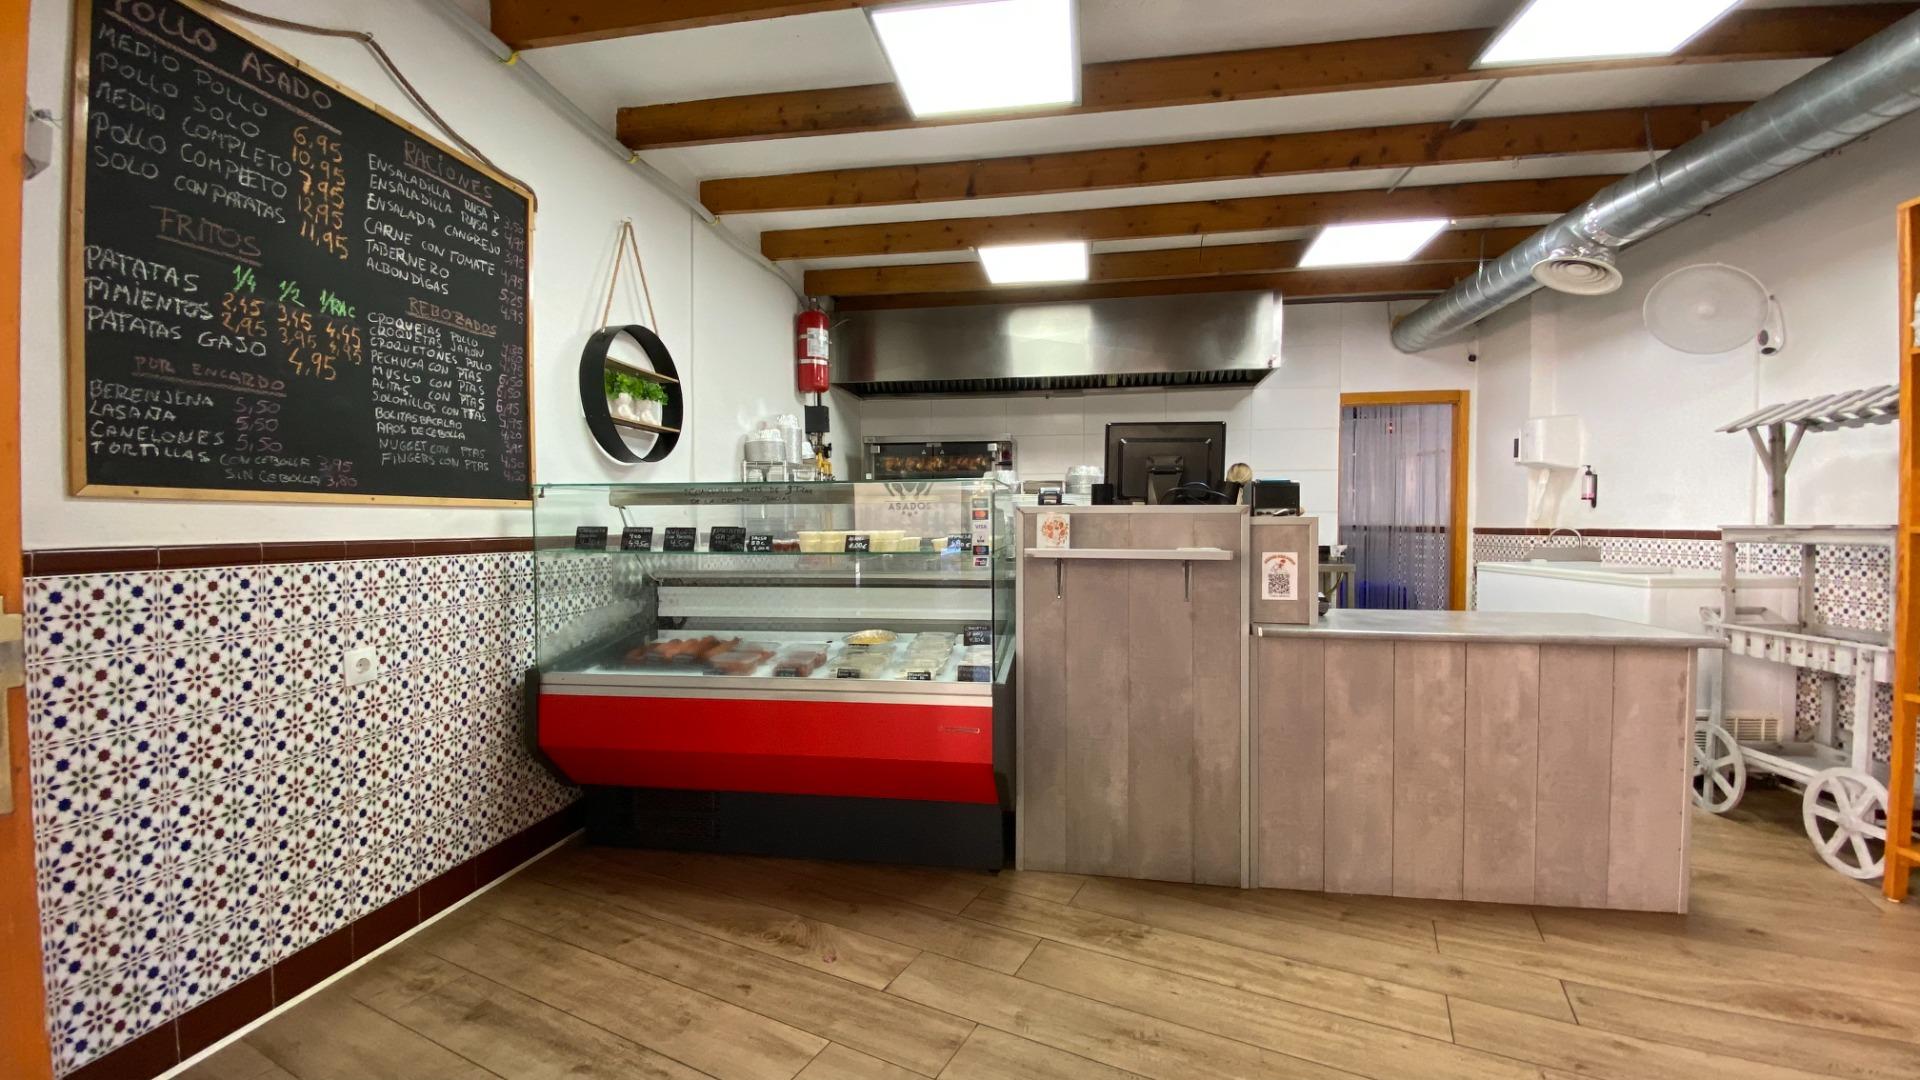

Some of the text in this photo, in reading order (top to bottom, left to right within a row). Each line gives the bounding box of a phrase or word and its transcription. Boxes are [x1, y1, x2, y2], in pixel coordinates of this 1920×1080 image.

[99, 23, 342, 162] MEDIO POLLO 6,95
[241, 52, 331, 109] ASADO
[96, 81, 165, 120] MEDIO
[182, 116, 292, 176] COMPLETO
[97, 53, 346, 187] POLLO SOLO 10,95
[91, 112, 344, 230] POLLO COMPLETO 12,95
[368, 153, 451, 200] ENSALADILLA
[404, 139, 493, 199] RACIONES
[95, 145, 349, 260] SOLO CON PATATAS 11,95
[370, 174, 453, 213] ENSALADILLA
[150, 205, 261, 257] FRITOS
[366, 193, 436, 229] ENSALADA
[444, 224, 501, 256] CANGREJO
[364, 217, 413, 246] CARNE
[421, 241, 445, 257] CON
[450, 250, 496, 276] TOMATE
[365, 239, 450, 279] TABERNERO
[84, 245, 200, 292] PATATAS
[366, 257, 449, 295] ALBONDIGAS
[83, 276, 214, 320] PIMIENTOS
[408, 297, 497, 335] REBOZADOS
[84, 306, 336, 381] PATATAS GAJO 4,95
[367, 312, 442, 338] CROQUETAS
[450, 331, 479, 347] POLLO
[369, 325, 442, 349] CROQUETAS
[135, 356, 176, 374] POR
[370, 337, 458, 365] CROQUETONES
[465, 357, 493, 372] POLLO
[371, 349, 424, 371] PECHUGA
[428, 362, 449, 375] CON
[90, 378, 281, 415] BERENJENA 5,50
[372, 365, 421, 384] MUSLO
[429, 378, 452, 388] CON
[457, 379, 485, 396] PTAS
[373, 391, 436, 413] SOLOMILLOS
[442, 406, 459, 416] CON
[375, 407, 418, 423] BOLITAS
[419, 416, 463, 430] BACALAO
[428, 391, 450, 402] CON
[458, 393, 485, 411] PTAS
[90, 420, 283, 452] CANELONES 5,50
[236, 416, 279, 432] 5,50
[377, 421, 407, 435] AROS
[411, 427, 424, 435] DE
[426, 428, 466, 440] CEBOLLA
[90, 440, 211, 463] TORTILLAS
[220, 454, 250, 466] CON
[380, 438, 428, 453] NUGGET
[430, 445, 450, 455] CON
[381, 452, 436, 467] FINGERS
[440, 458, 459, 468] CON
[224, 468, 254, 481] SIN
[259, 470, 321, 486] CEBOLLA
